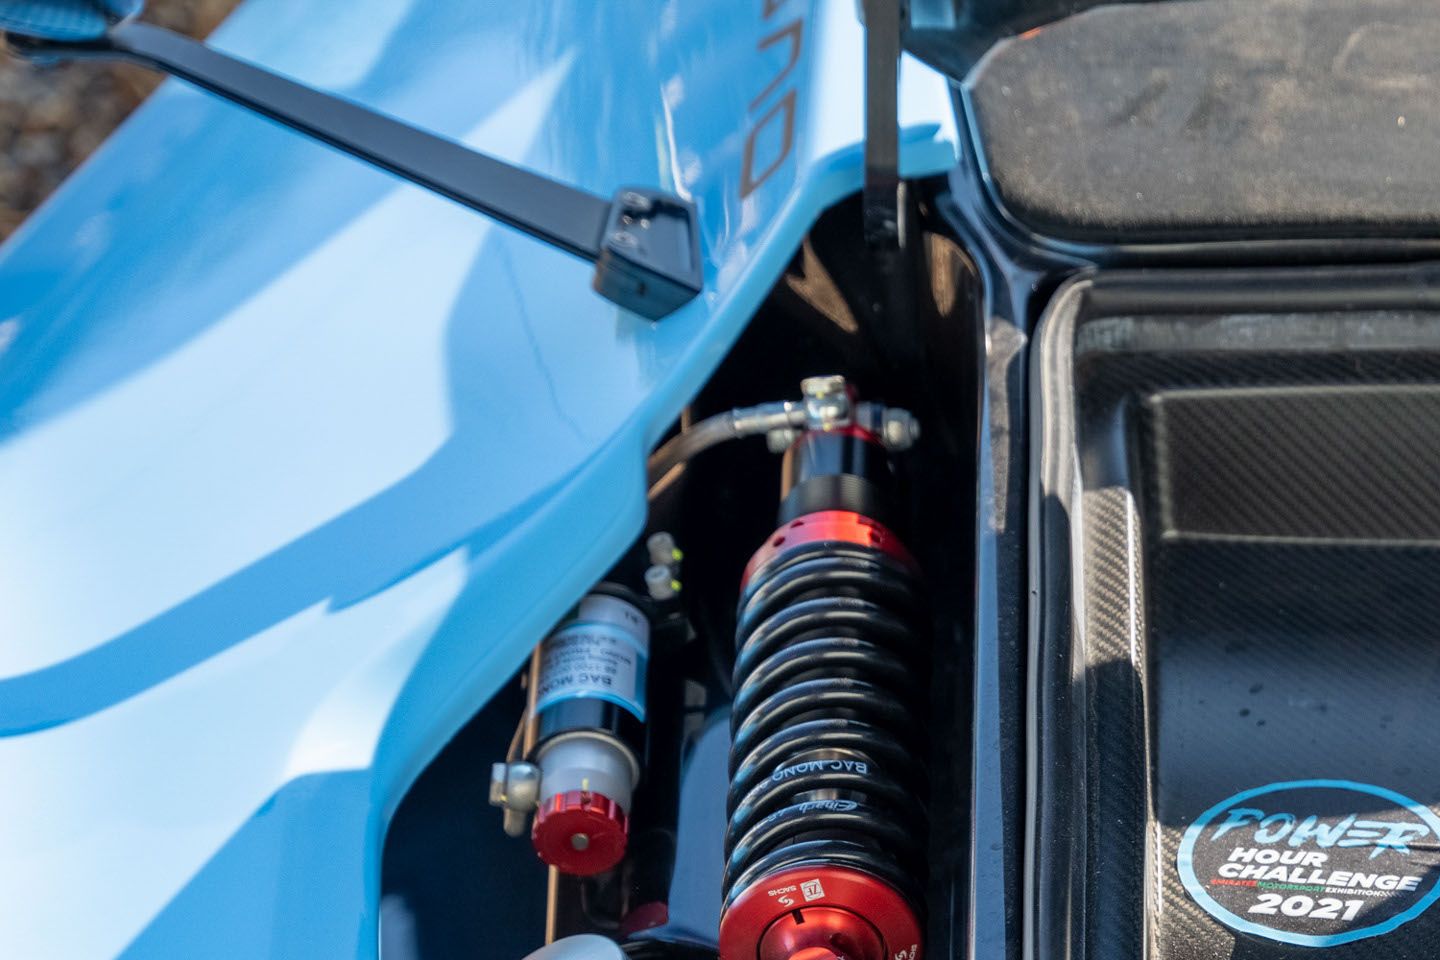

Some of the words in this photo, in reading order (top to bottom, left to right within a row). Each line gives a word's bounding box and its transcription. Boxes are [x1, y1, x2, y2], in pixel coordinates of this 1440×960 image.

[772, 761, 824, 781] MONO
[831, 760, 868, 774] BAC
[1210, 808, 1430, 860] POWER
[1227, 847, 1329, 867] HOUR
[1217, 863, 1423, 891] CHALLENGE
[767, 885, 797, 897] SACHS
[1325, 886, 1382, 897] EXHIBITION
[1248, 894, 1364, 921] 2021
